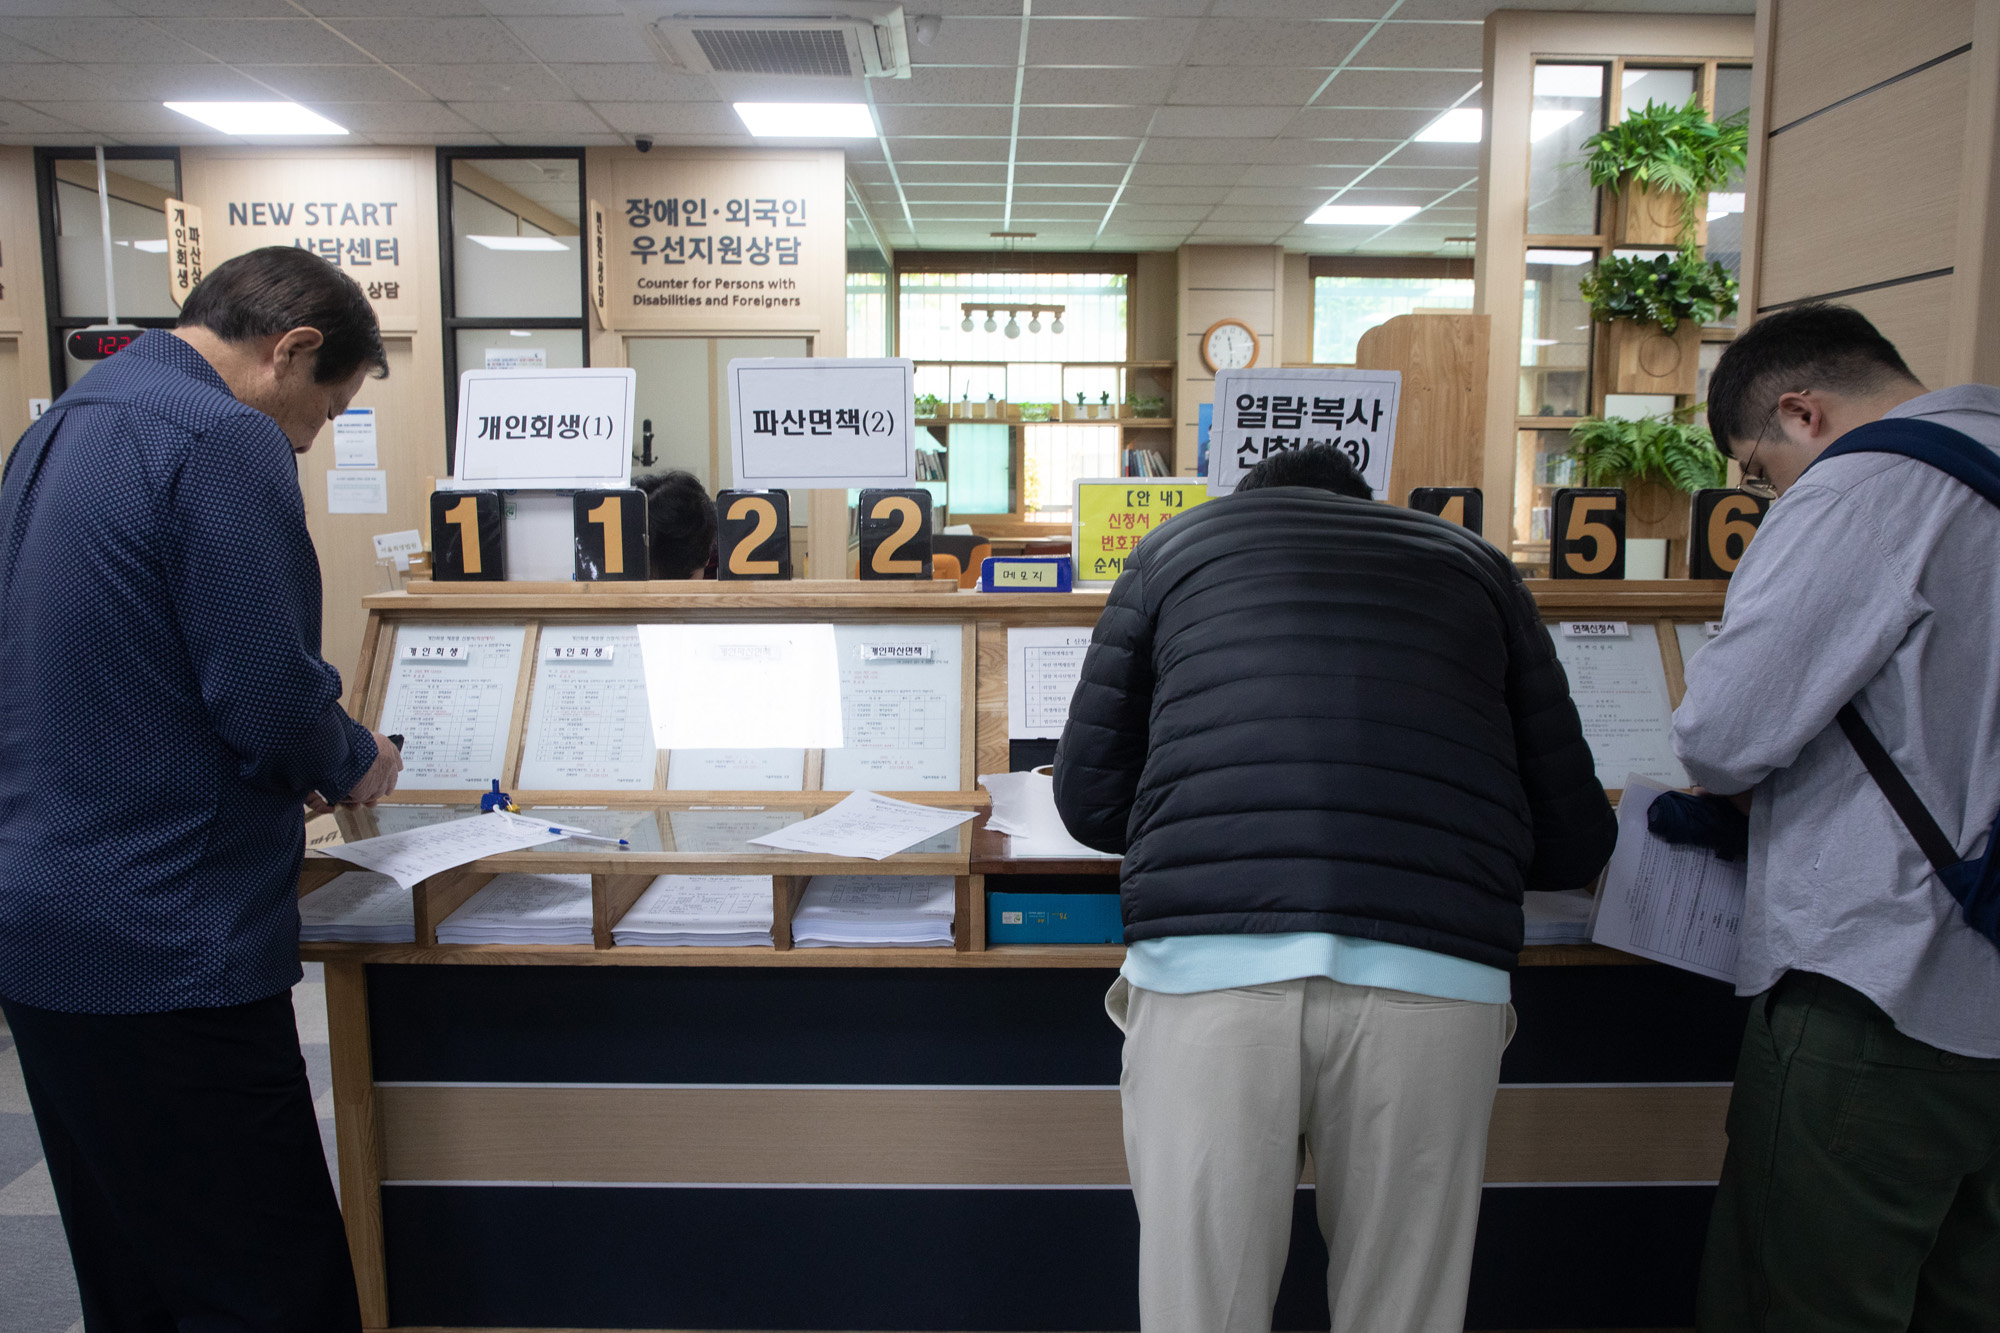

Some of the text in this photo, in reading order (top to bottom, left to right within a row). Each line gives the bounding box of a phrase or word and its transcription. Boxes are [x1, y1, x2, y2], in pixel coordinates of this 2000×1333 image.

[229, 203, 398, 226] NEW START
[625, 198, 807, 228] 장애인·외국인
[174, 208, 189, 289] 개인회생
[631, 235, 801, 266] 우선지원상담
[367, 281, 399, 299] 상담
[637, 277, 796, 290] Counter for Persons with
[633, 294, 801, 309] Disabilities and Foreigners
[35, 403, 42, 416] 1
[752, 407, 895, 438] 파산면책(2)
[1236, 393, 1384, 433] 열람·복사
[477, 413, 614, 442] 개인회생(1)
[445, 497, 482, 574] 1
[588, 497, 623, 573] 1
[726, 496, 779, 575] 2
[870, 496, 922, 574] 2
[1108, 513, 1149, 529] 신청서
[1565, 497, 1617, 574] 5
[1708, 495, 1760, 573] 6
[1572, 624, 1616, 634] 면책신청서
[871, 646, 923, 657] 개인파산면책
